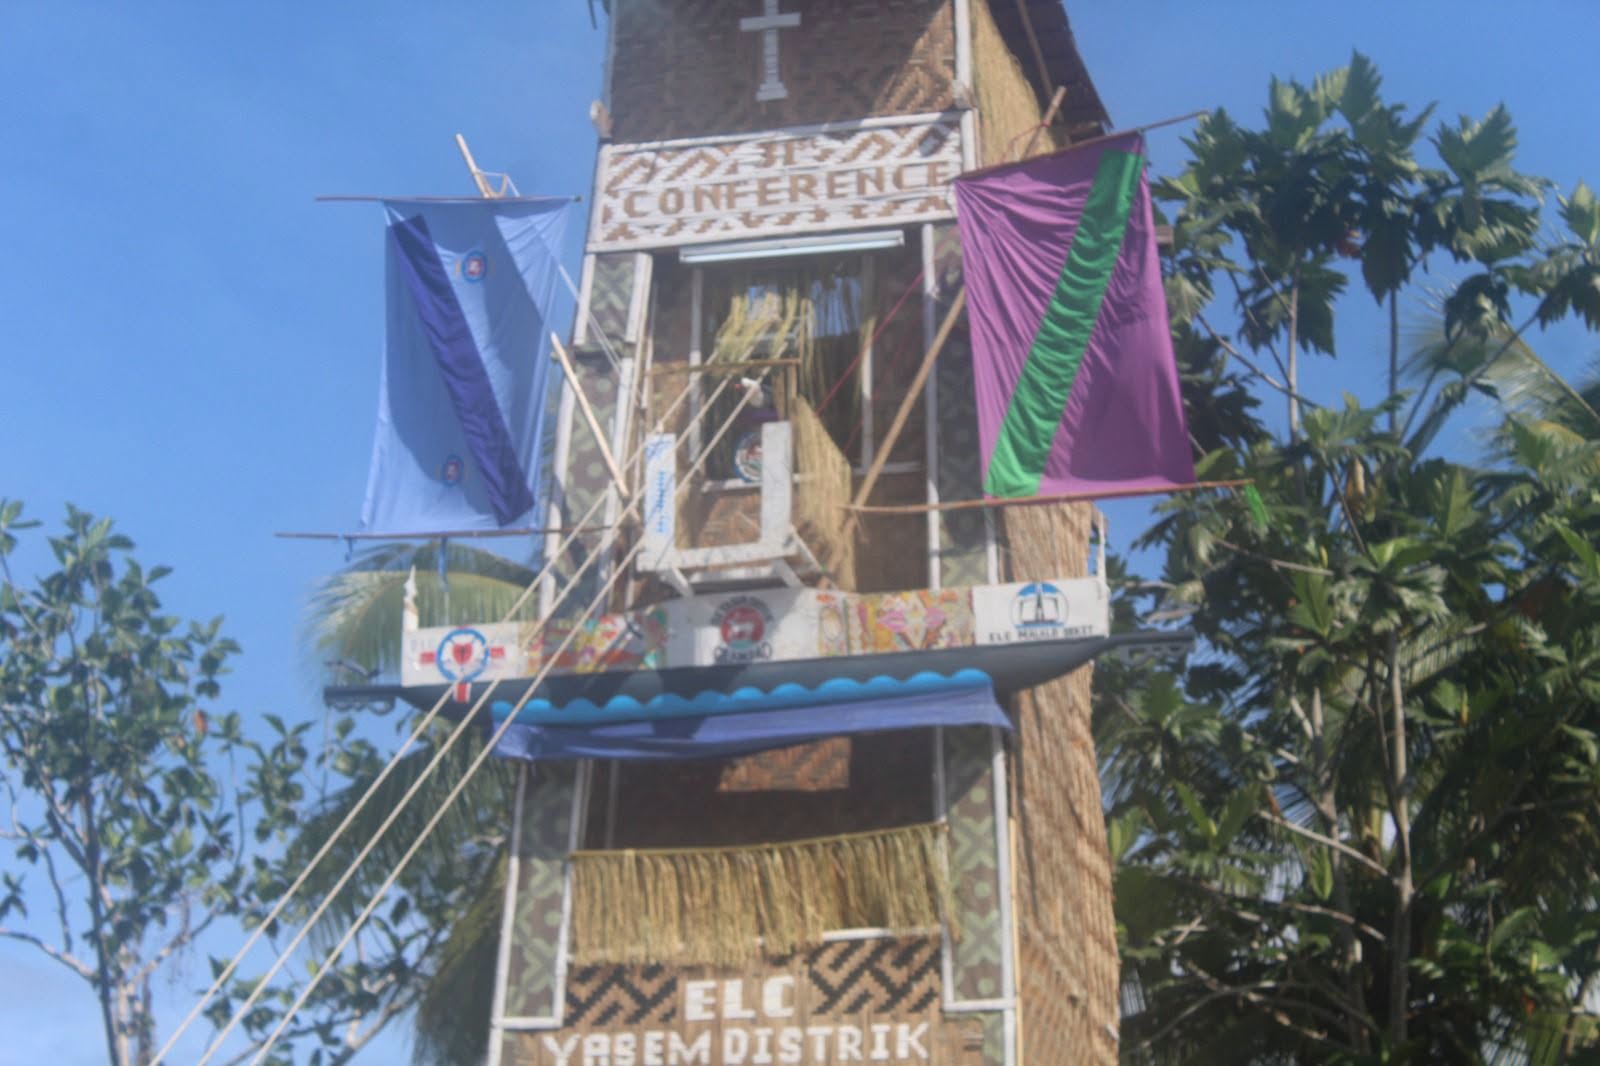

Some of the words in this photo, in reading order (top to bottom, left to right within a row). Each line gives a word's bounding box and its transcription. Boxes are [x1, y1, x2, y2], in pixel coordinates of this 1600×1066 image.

[623, 162, 951, 218] CONFERENCE
[685, 975, 795, 1020] ELC
[723, 1022, 929, 1065] DISTRIK
